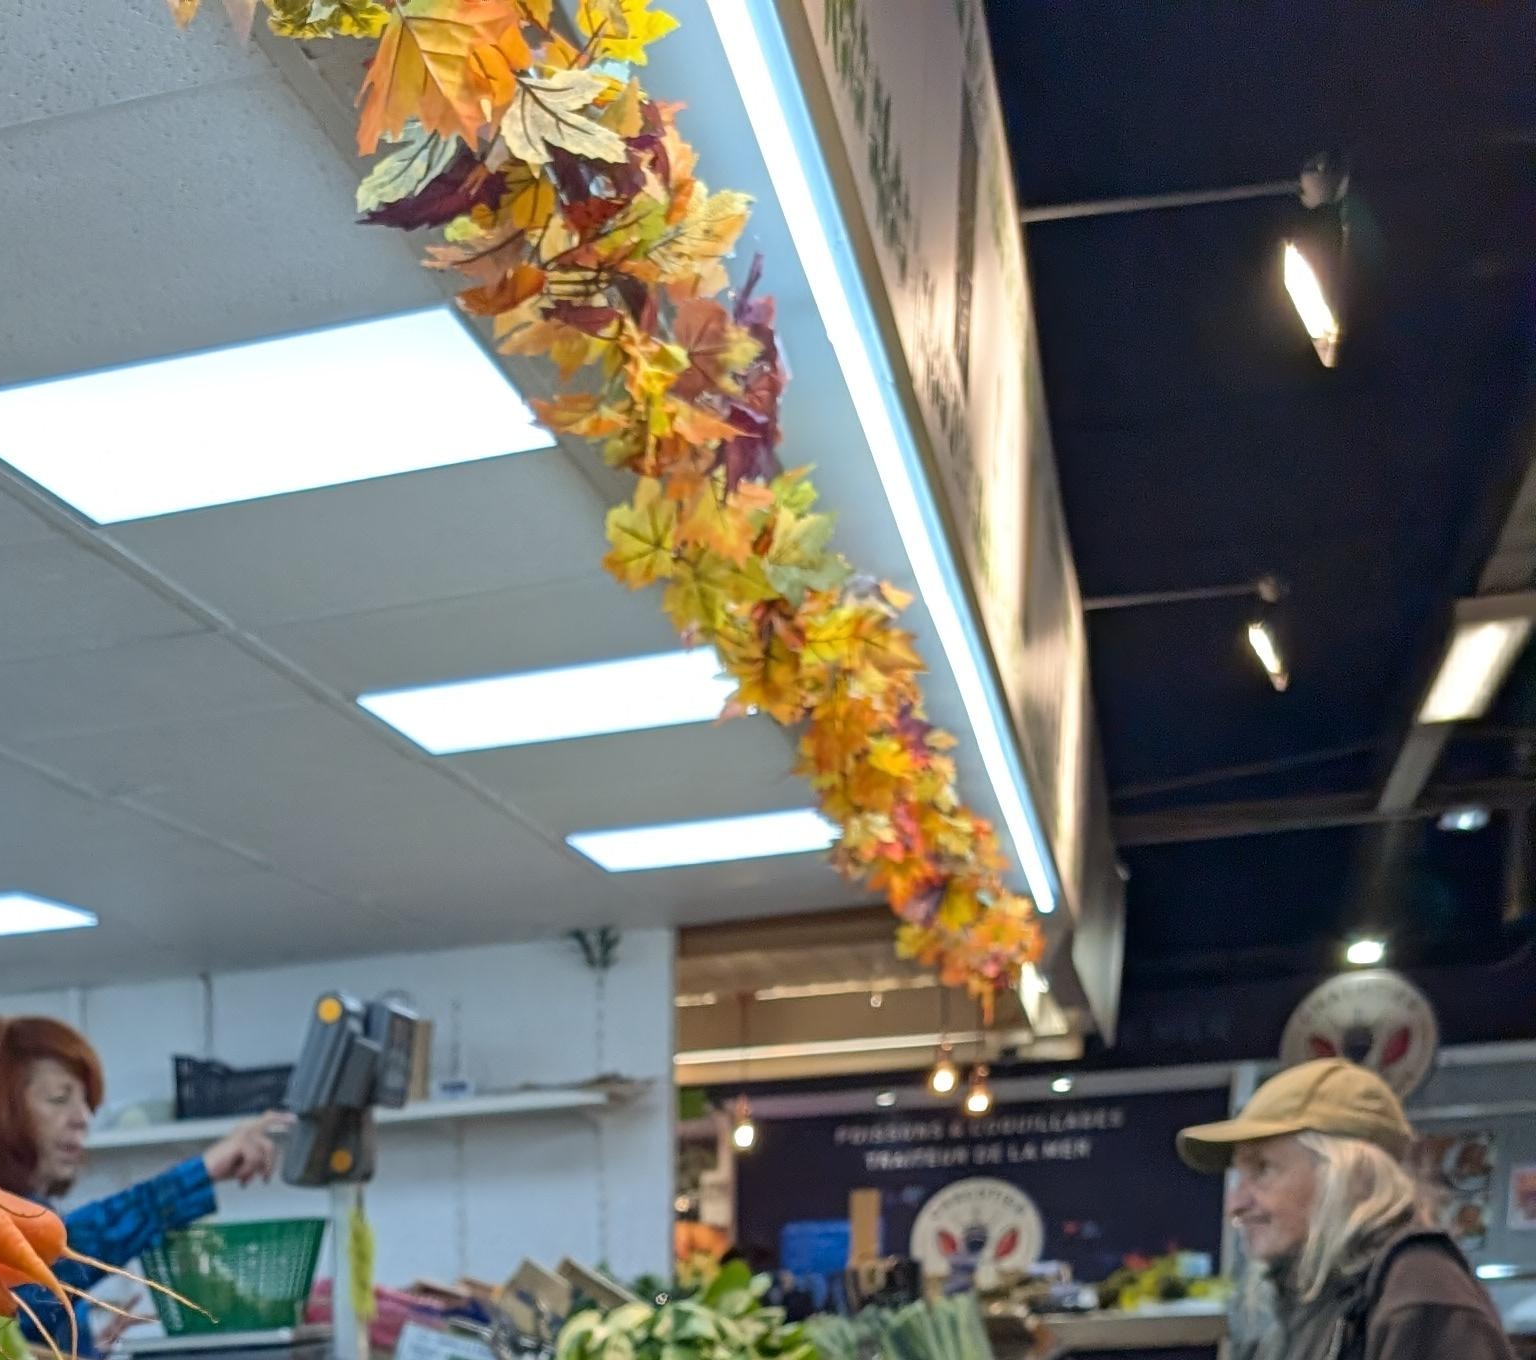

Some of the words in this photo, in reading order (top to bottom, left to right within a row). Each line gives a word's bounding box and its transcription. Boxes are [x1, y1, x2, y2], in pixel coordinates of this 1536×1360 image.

[972, 1142, 1002, 1165] DE
[1007, 1140, 1037, 1162] LA
[1042, 1138, 1092, 1161] MER
